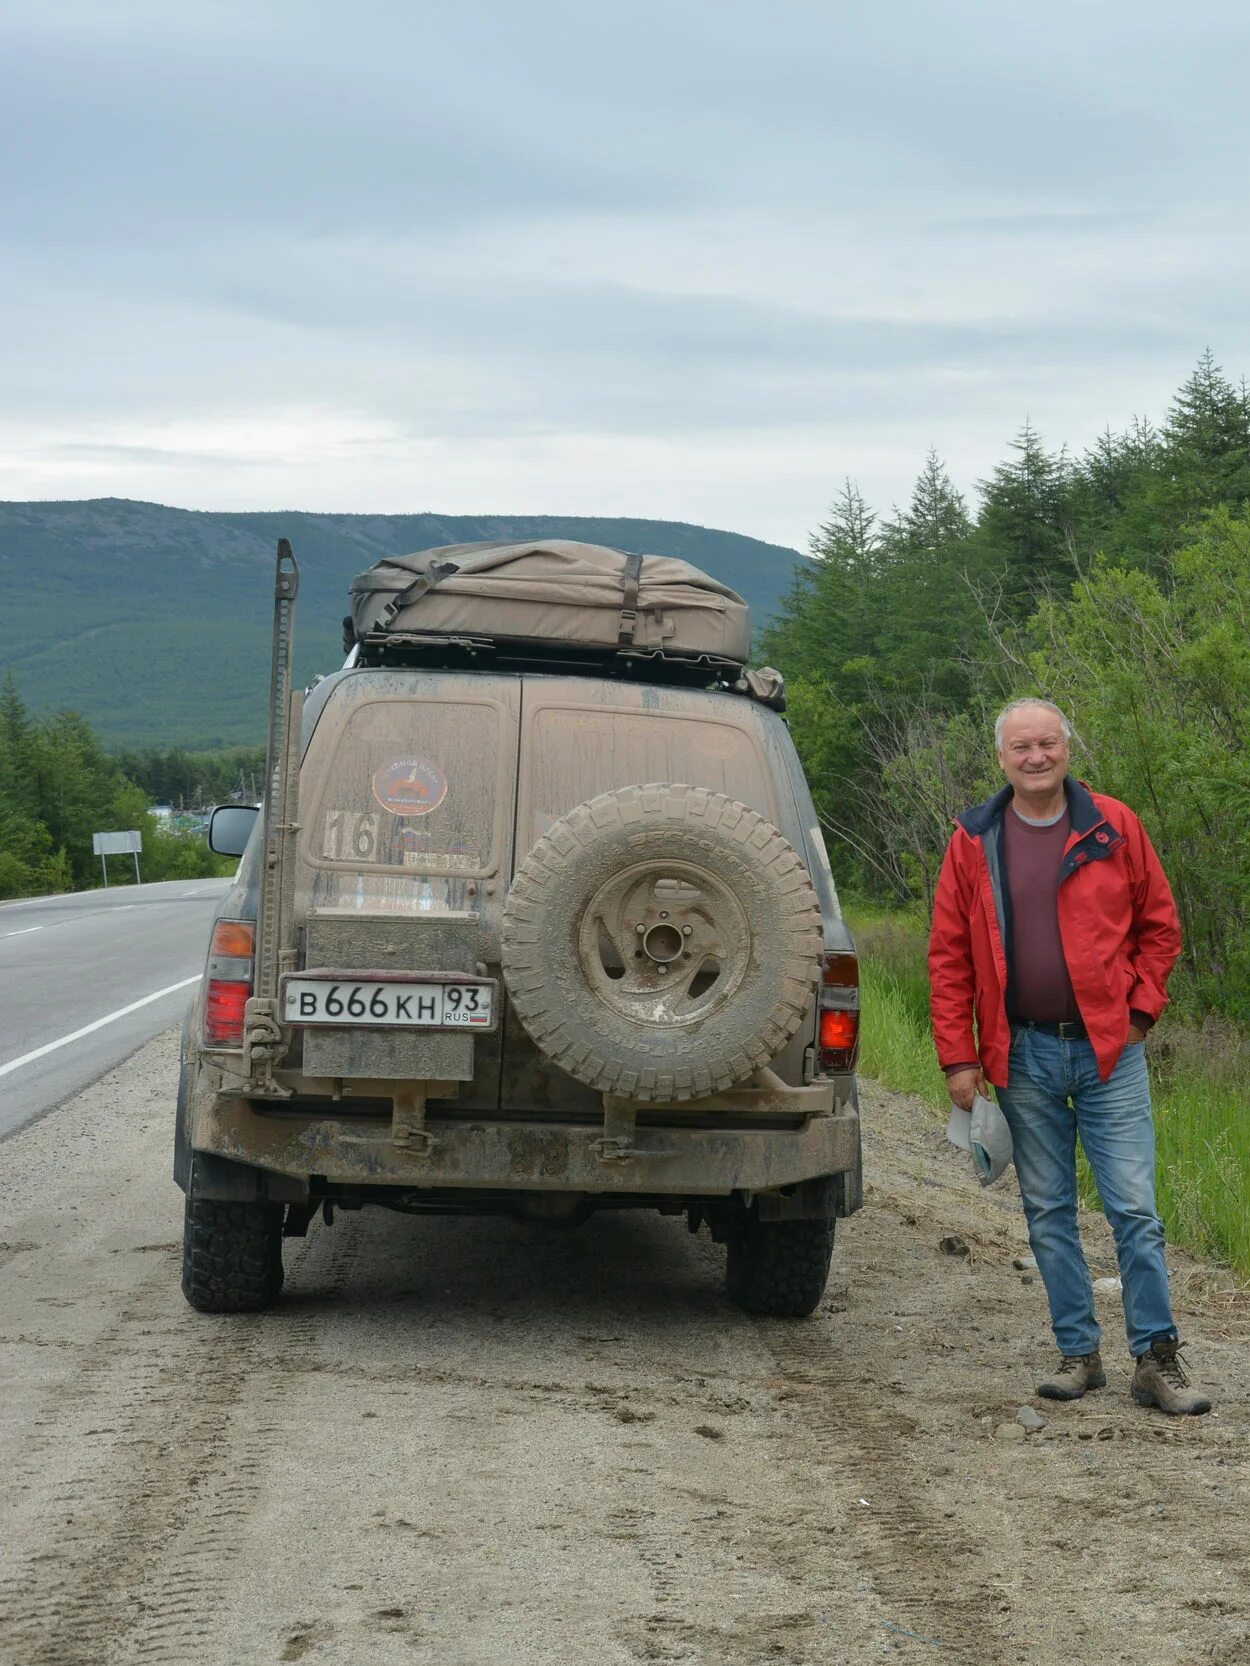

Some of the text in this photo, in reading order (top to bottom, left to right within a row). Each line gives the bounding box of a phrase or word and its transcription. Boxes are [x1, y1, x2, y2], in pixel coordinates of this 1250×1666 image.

[327, 813, 377, 859] 16
[447, 987, 480, 1012] 93
[444, 1012, 469, 1022] RUS
